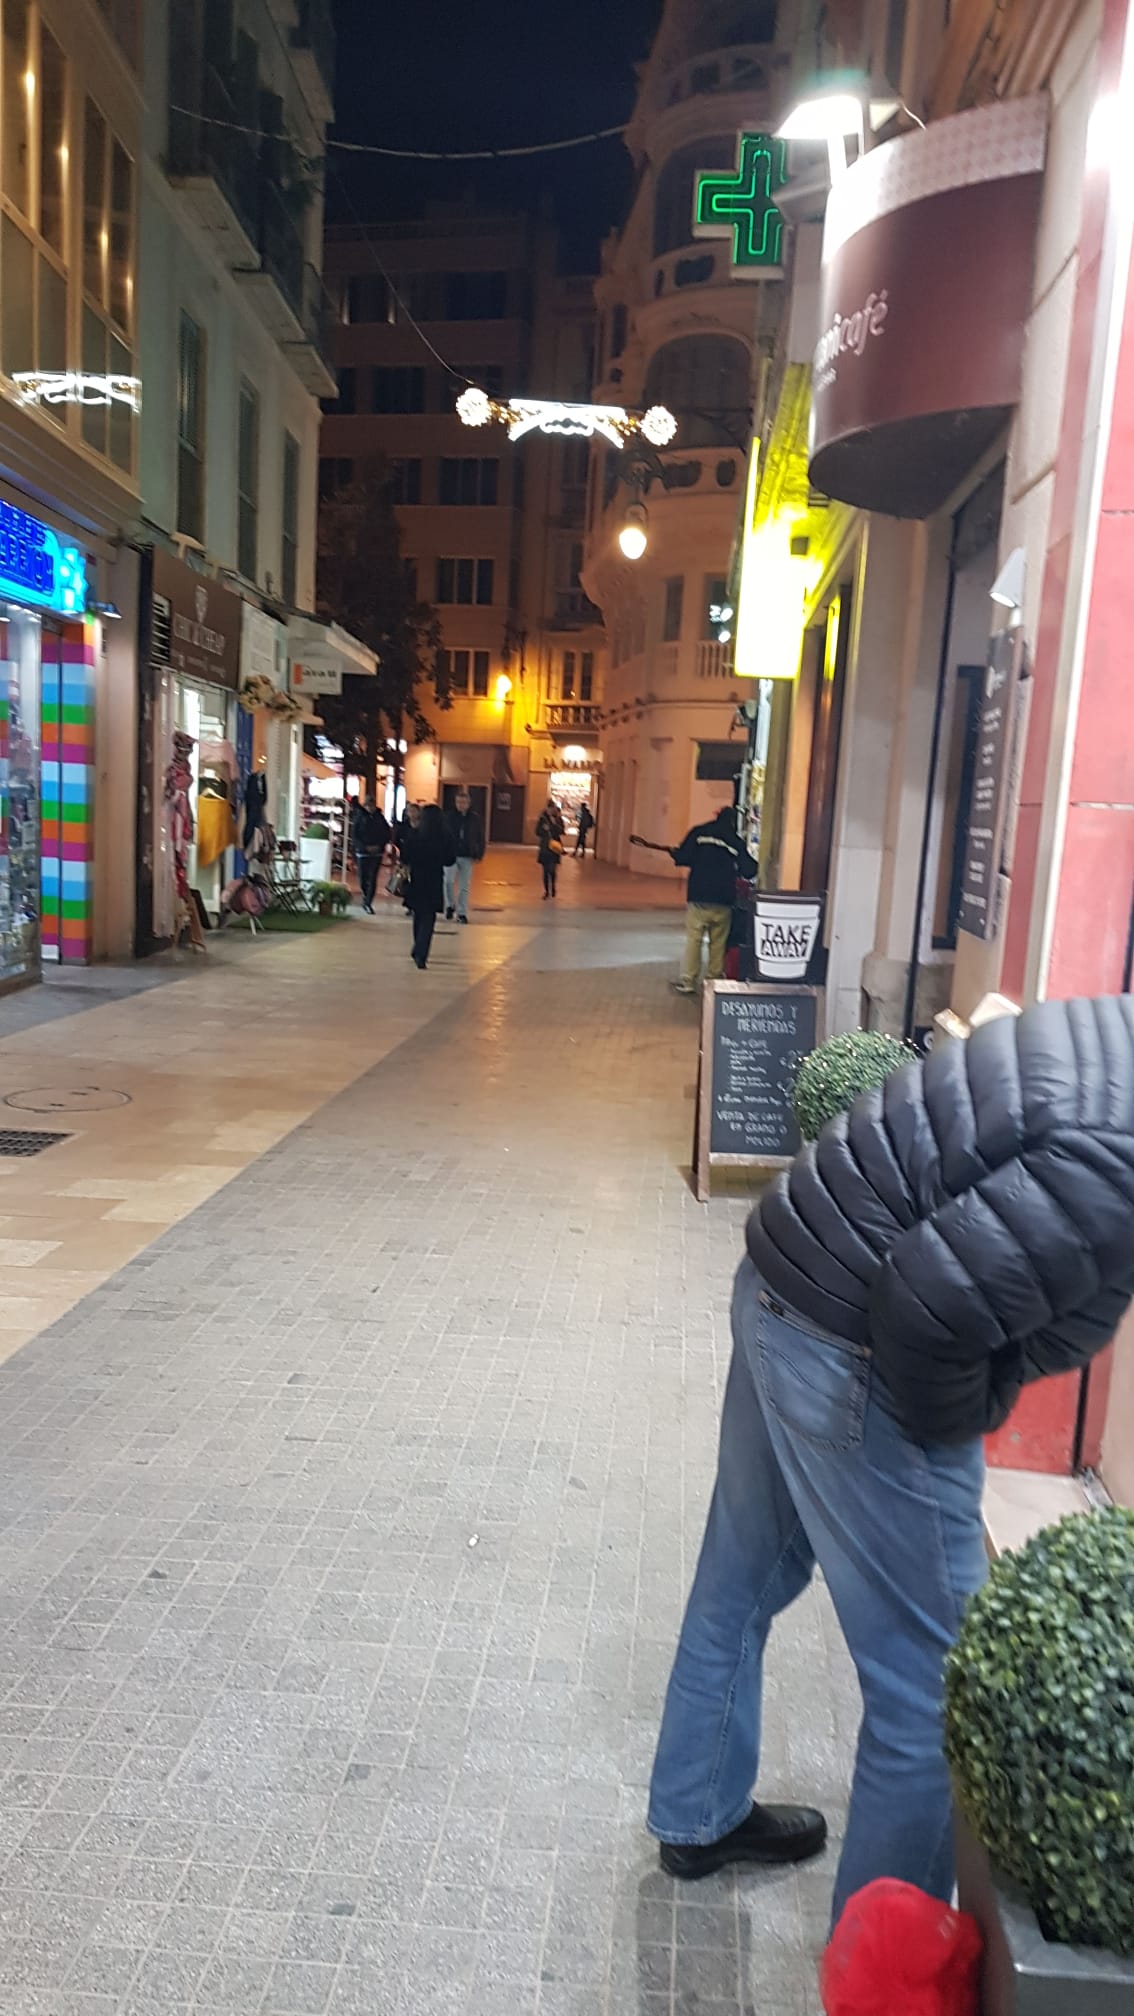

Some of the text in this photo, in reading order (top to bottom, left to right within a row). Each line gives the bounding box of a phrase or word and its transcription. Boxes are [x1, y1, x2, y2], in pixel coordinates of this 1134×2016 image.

[761, 922, 812, 945] TAKE
[760, 938, 808, 957] AWAY
[721, 1000, 784, 1019] DESAYUNOS
